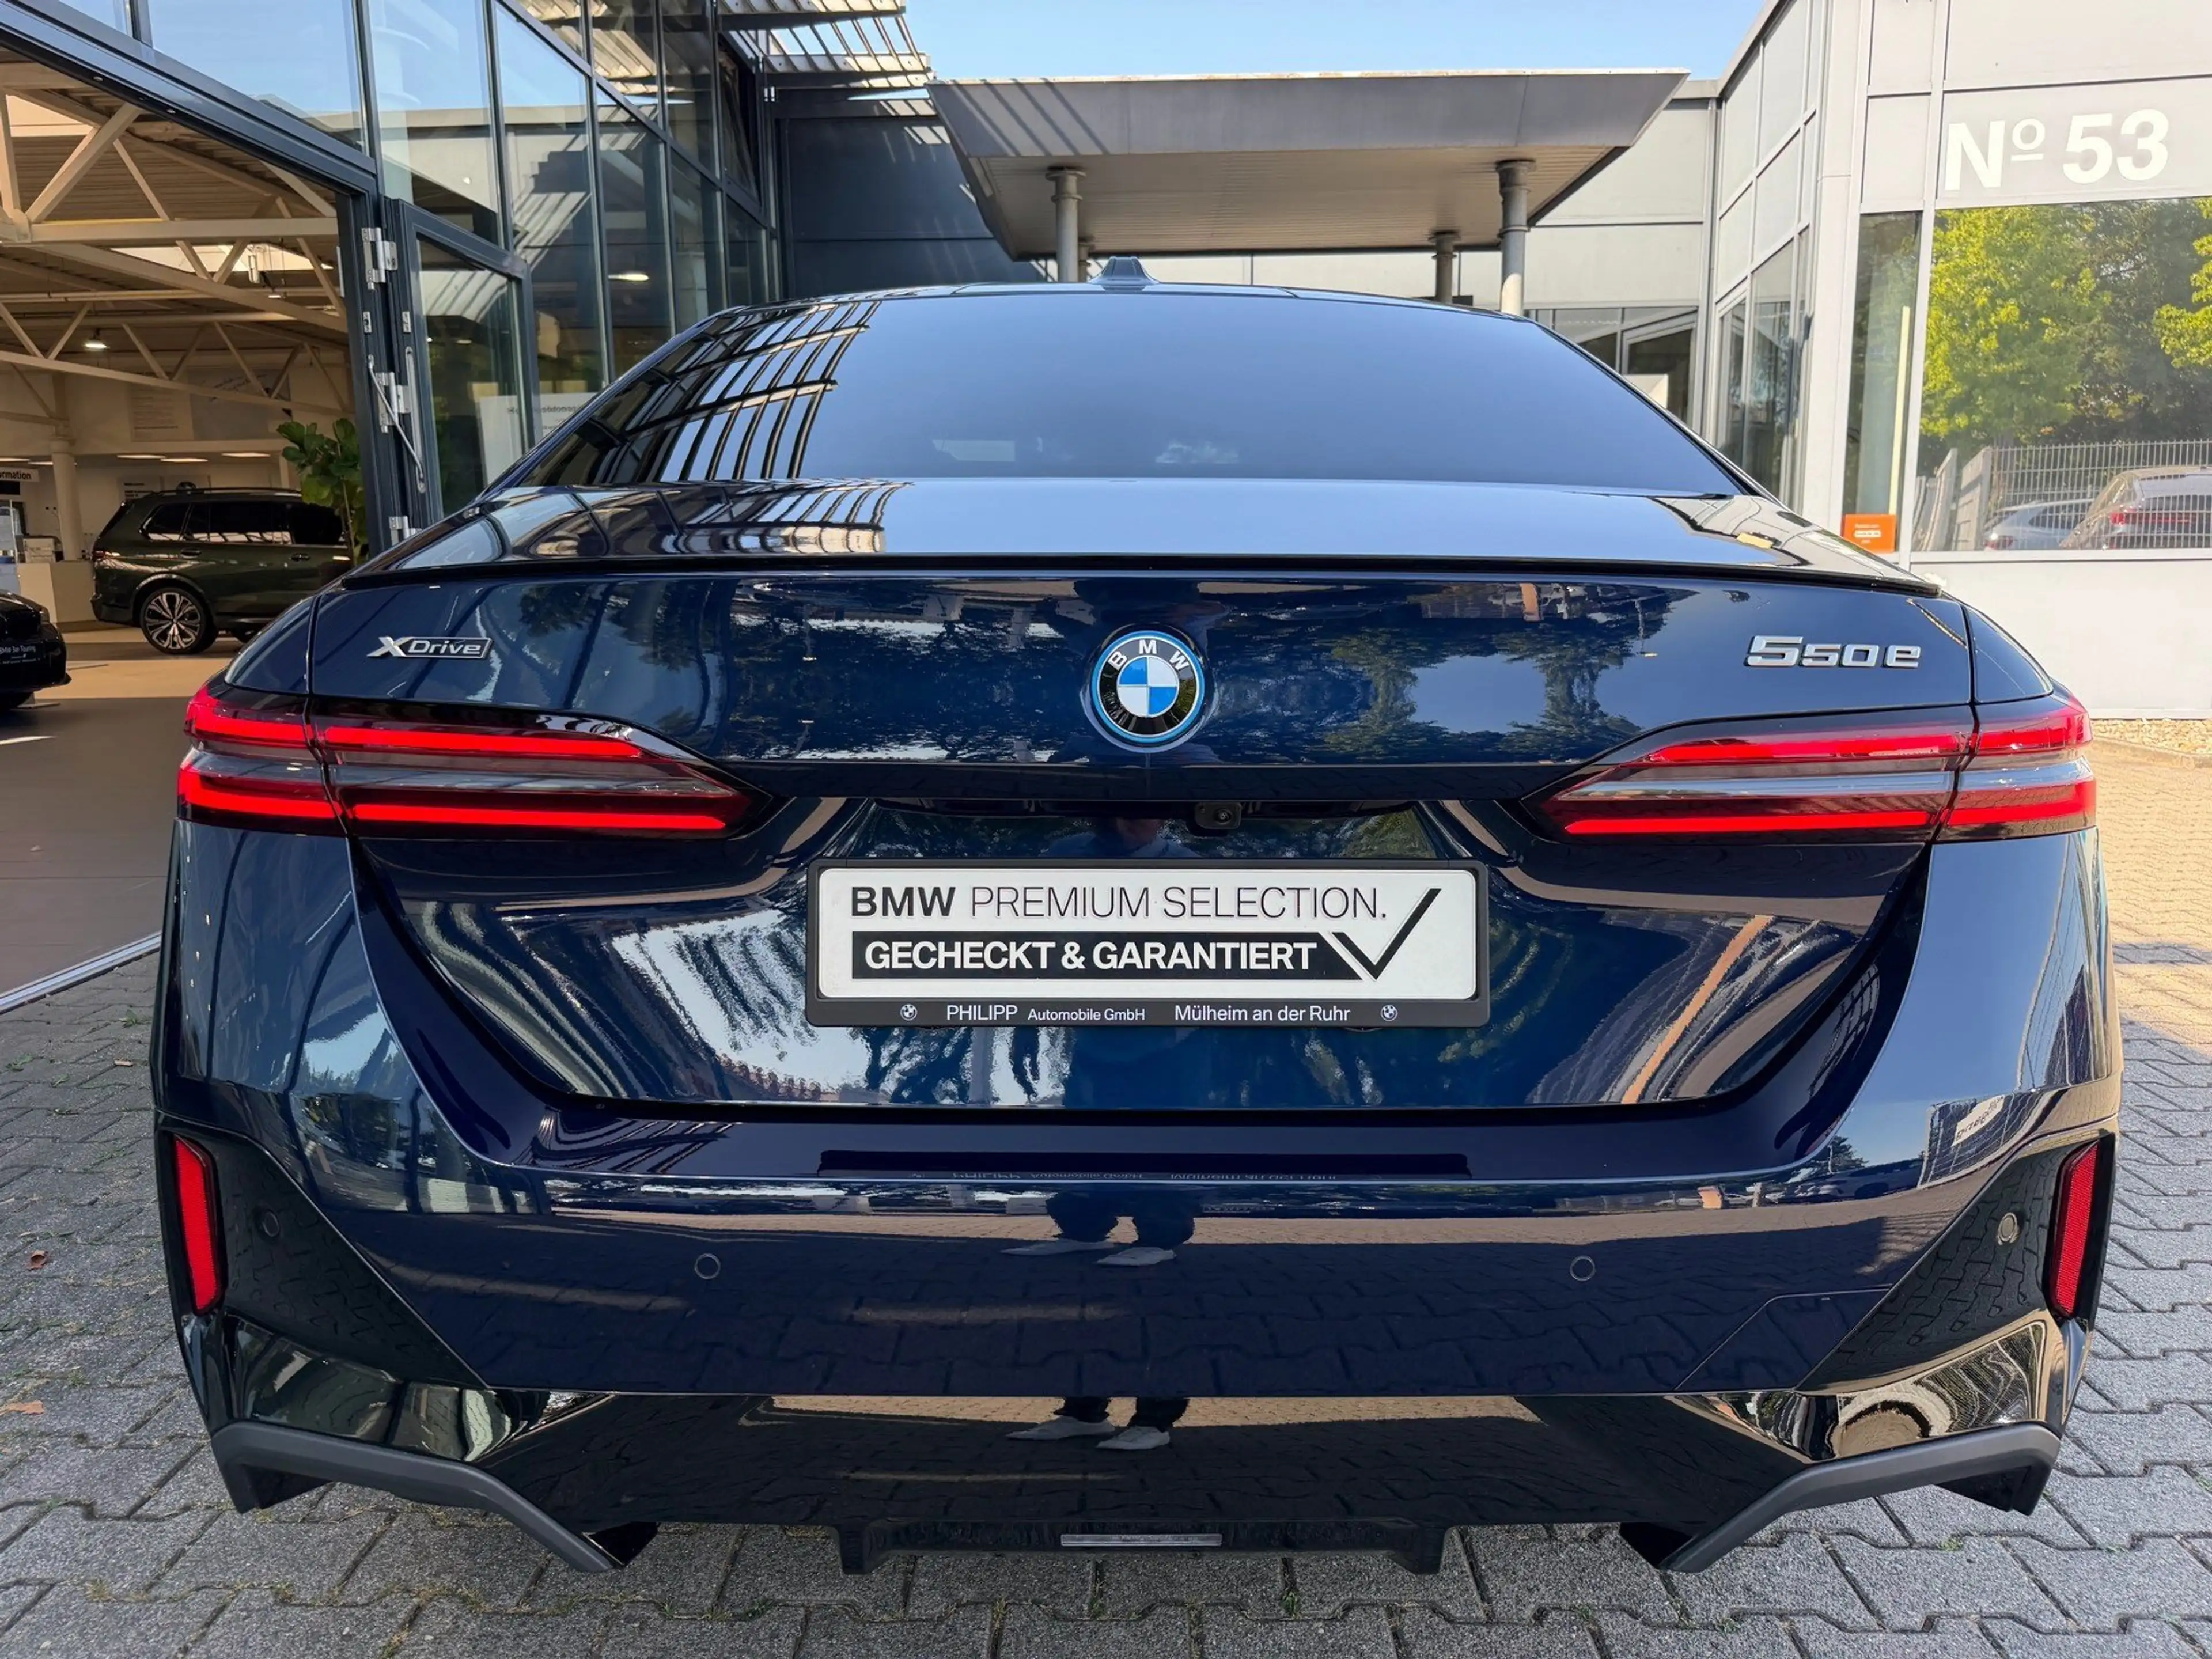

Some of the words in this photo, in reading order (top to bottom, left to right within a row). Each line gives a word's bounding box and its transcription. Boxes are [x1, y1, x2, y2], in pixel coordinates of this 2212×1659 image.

[2062, 109, 2169, 184] 53
[1107, 639, 1189, 671] BMW
[852, 887, 956, 916] BMW
[972, 887, 1149, 917] PREMIUM
[1162, 887, 1387, 918] SELECTION.
[865, 941, 1056, 969] GECHECKT
[1061, 941, 1086, 969] &
[1093, 941, 1317, 969] GARANTIERT
[946, 1004, 1018, 1021] PHILIPP
[1027, 1008, 1101, 1021] Automobile
[1104, 1008, 1146, 1021] GmbH
[1175, 1005, 1248, 1021] Mülheim
[1252, 1009, 1273, 1021] an
[1277, 1006, 1306, 1021] der
[1309, 1006, 1351, 1021] Ruhr
